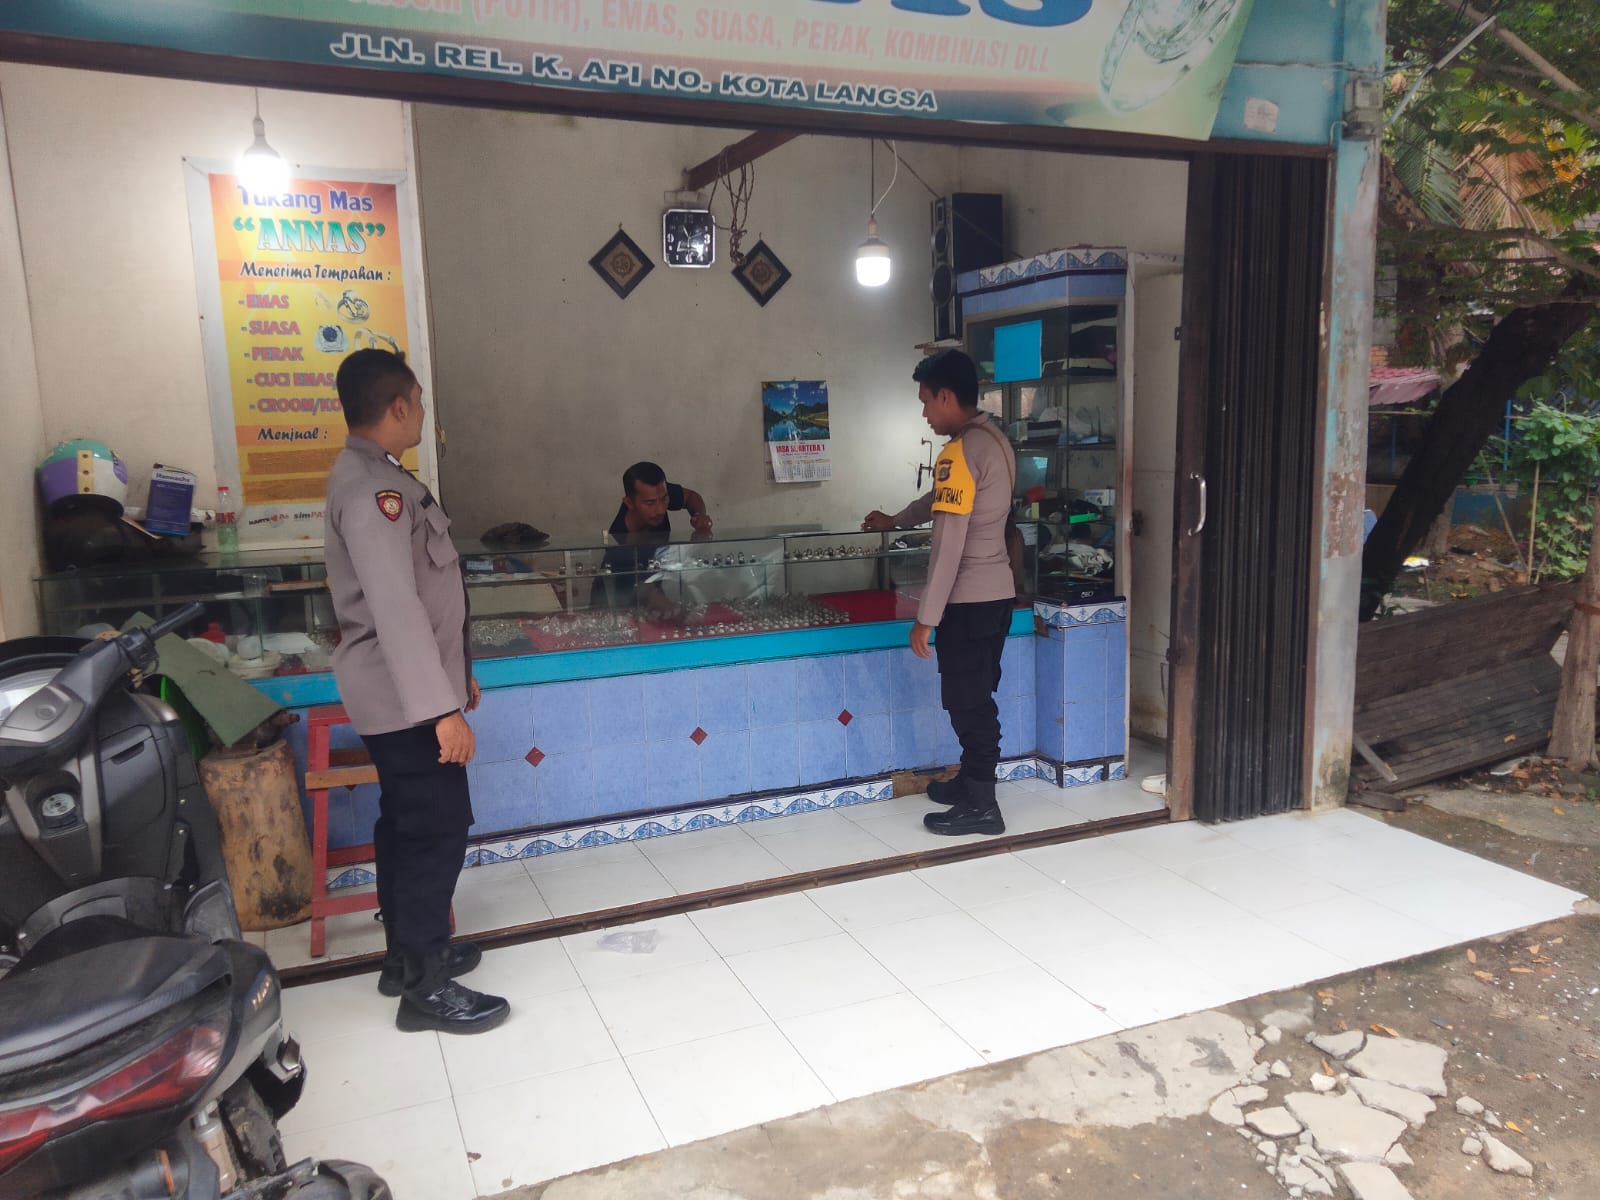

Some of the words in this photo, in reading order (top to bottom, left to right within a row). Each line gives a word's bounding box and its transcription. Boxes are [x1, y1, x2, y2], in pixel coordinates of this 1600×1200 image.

[601, 0, 684, 40] EMAS,
[695, 6, 782, 48] SUASA,
[792, 18, 874, 59] PERAK,
[883, 29, 1009, 69] KOMBINASI
[1014, 43, 1049, 72] DLL
[330, 33, 425, 64] JLN.
[435, 42, 522, 75] REL.
[532, 53, 572, 80] K.
[580, 58, 642, 86] API
[651, 65, 711, 93] NO.
[720, 71, 807, 100] KOTA
[815, 80, 937, 111] LANGSA
[329, 190, 373, 212] Mas
[240, 262, 311, 279] Menerima
[314, 264, 383, 282] Tempahan
[246, 293, 289, 309] EMAS
[249, 320, 301, 335] SUASA
[252, 347, 304, 361] PERAK
[255, 372, 290, 387] CUCI
[258, 428, 319, 442] Menjual
